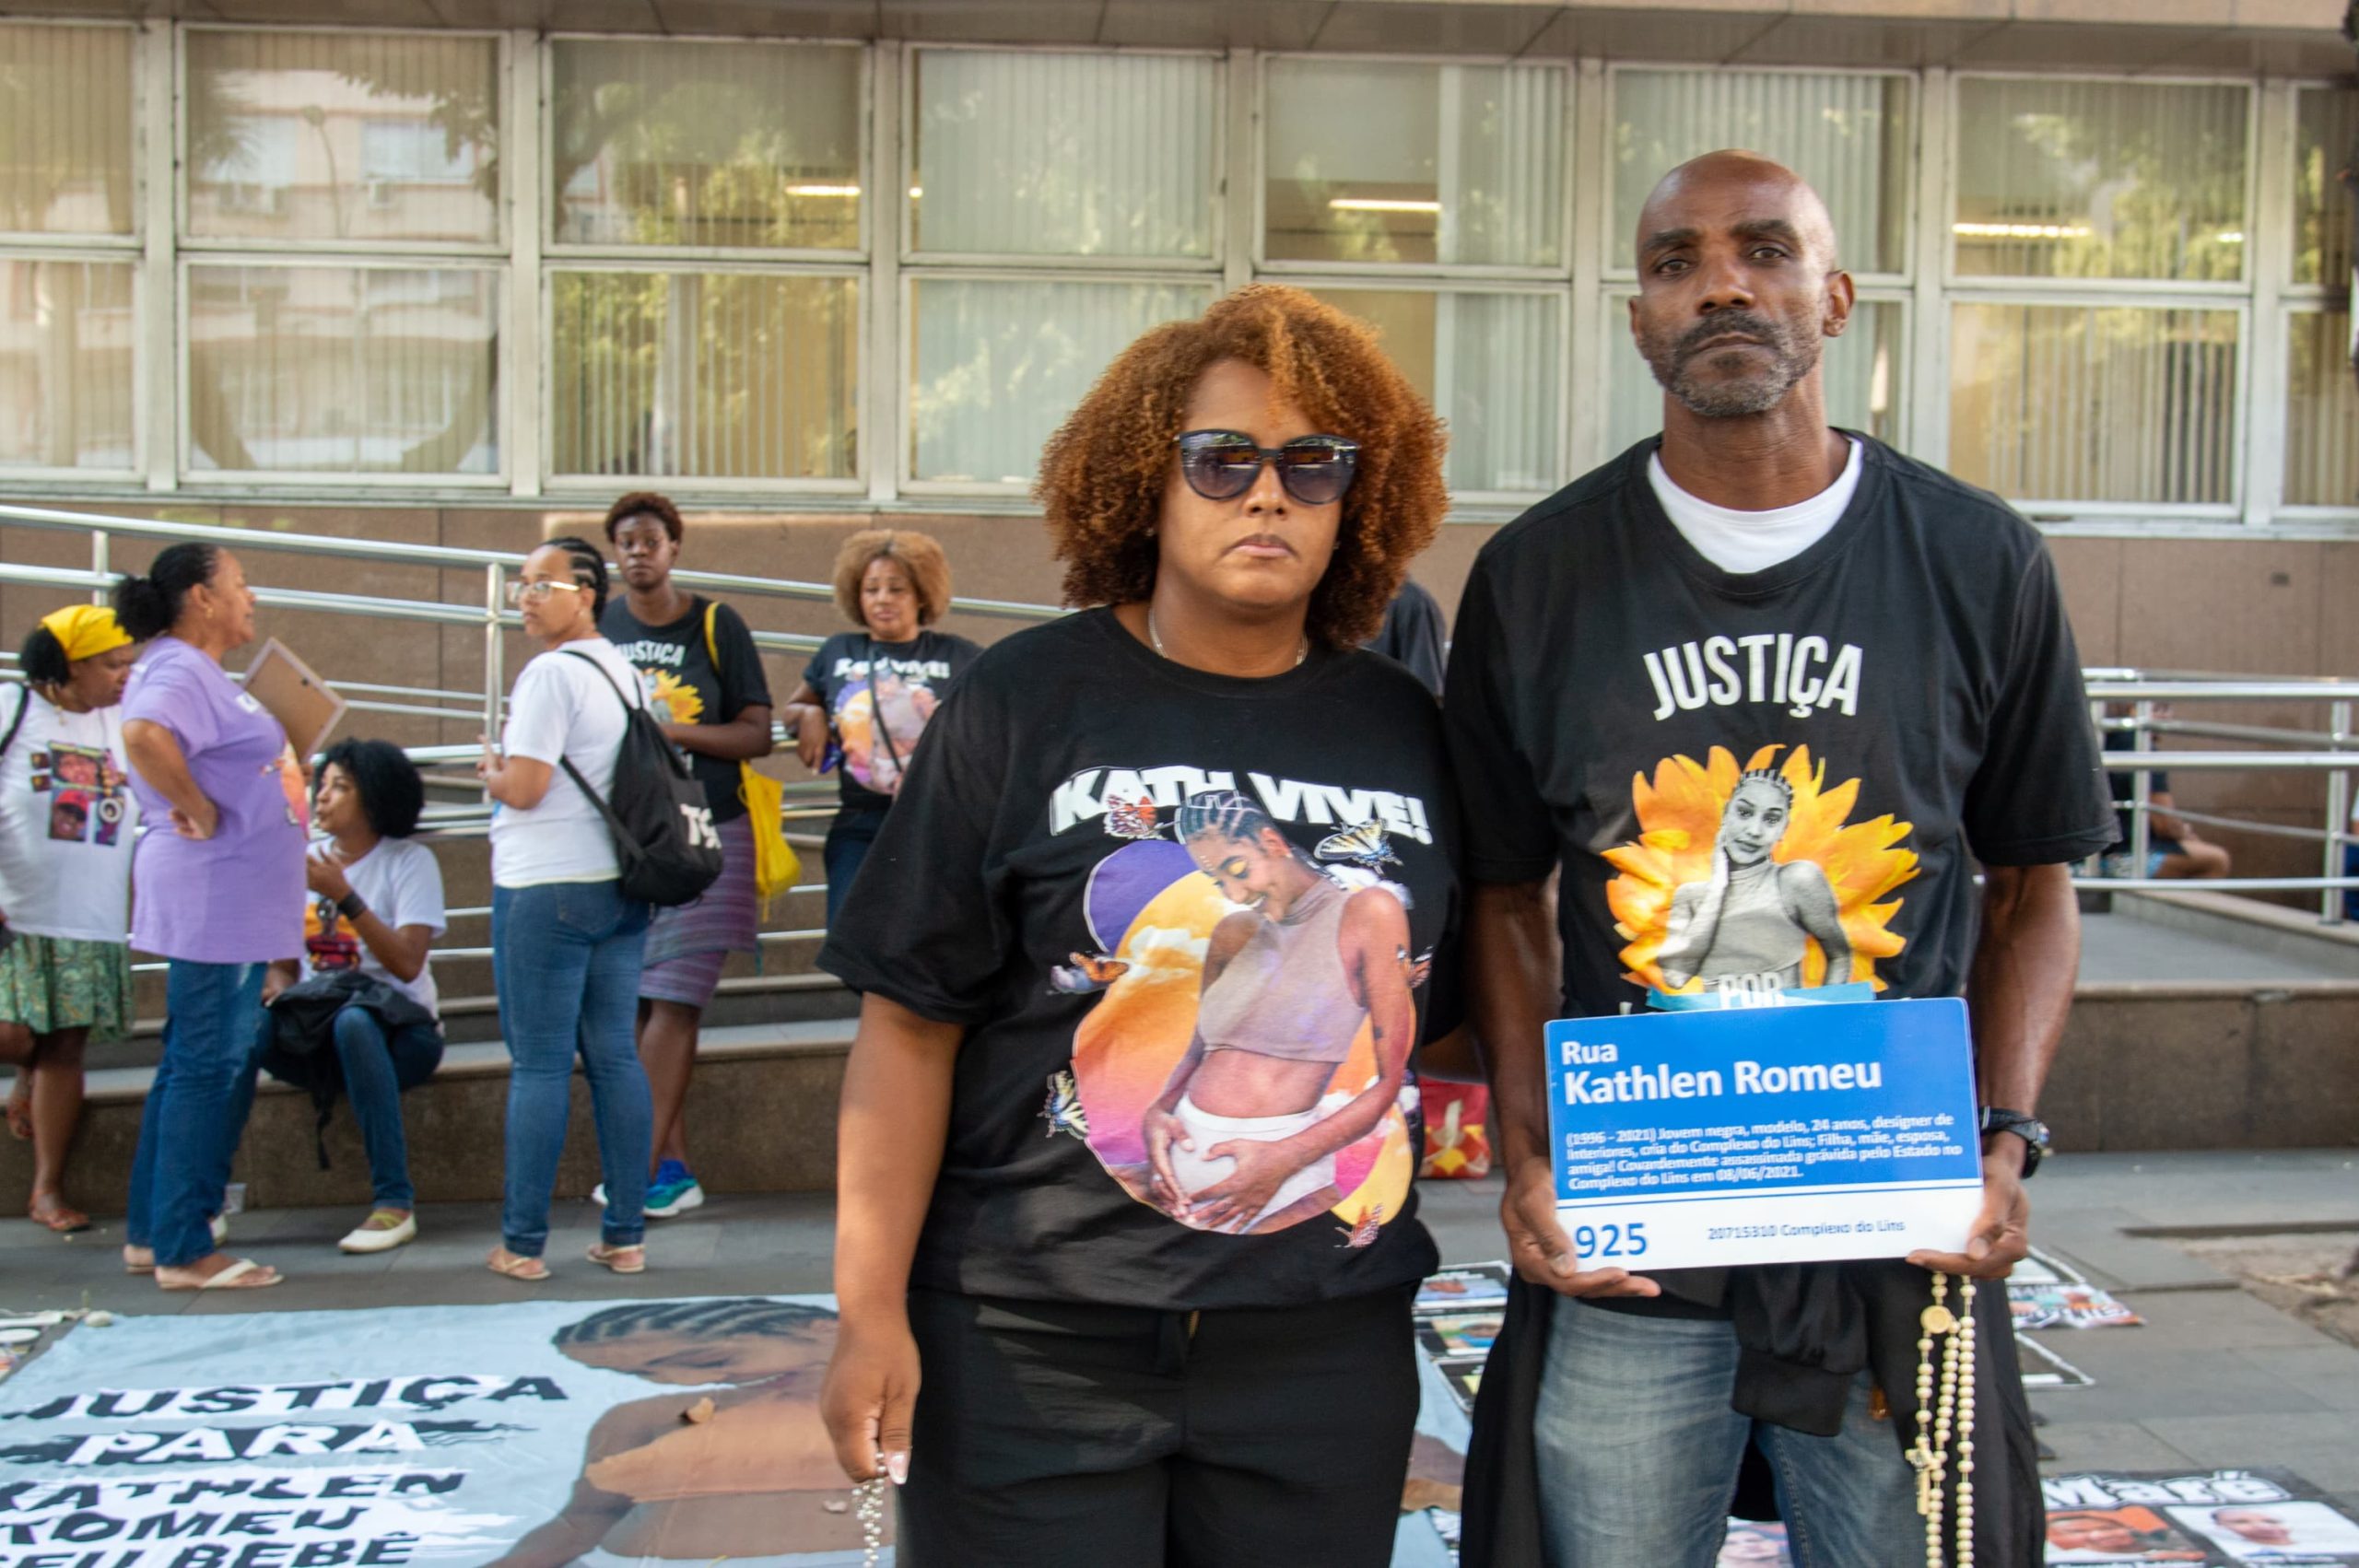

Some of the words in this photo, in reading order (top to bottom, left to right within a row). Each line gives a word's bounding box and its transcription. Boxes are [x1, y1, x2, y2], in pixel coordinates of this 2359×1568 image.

[1643, 633, 1863, 721] JUSTIÇA
[1050, 766, 1240, 836] KATH
[1248, 772, 1433, 845] VIVE!
[1719, 971, 1786, 1010] POR
[1561, 1041, 1618, 1065] Rua
[1565, 1063, 1722, 1105] Kathlen
[1734, 1060, 1882, 1094] Romeu
[1657, 1128, 1703, 1141] Jovem
[1705, 1125, 1750, 1139] negra,
[1752, 1119, 1810, 1134] modelo,
[1811, 1118, 1831, 1131] 24
[1832, 1117, 1871, 1131] anos,
[1872, 1114, 1933, 1129] designer
[1934, 1113, 1954, 1126] de
[1669, 1141, 1689, 1153] do
[1689, 1139, 1760, 1153] Complexo
[1761, 1137, 1781, 1149] do
[1817, 1132, 1857, 1147] Filha,
[1858, 1131, 1895, 1145] mãe,
[1895, 1130, 1951, 1144] esposa,
[1617, 1155, 1719, 1172] Covardemente
[1720, 1149, 1803, 1166] assassinada
[1804, 1148, 1858, 1164] grávida
[1859, 1146, 1891, 1162] pelo
[1893, 1144, 1942, 1158] Estado
[1942, 1144, 1964, 1156] no
[1568, 1175, 1638, 1191] Complexo
[1639, 1172, 1660, 1185] do
[1661, 1171, 1690, 1185] Lins
[1690, 1171, 1715, 1183] em
[1576, 1223, 1649, 1258] 925
[1780, 1222, 1851, 1237] Complexo
[1855, 1220, 1873, 1233] do
[1876, 1219, 1906, 1233] Lins
[0, 1376, 569, 1420] JUSTIÇA
[66, 1420, 426, 1466] PARA
